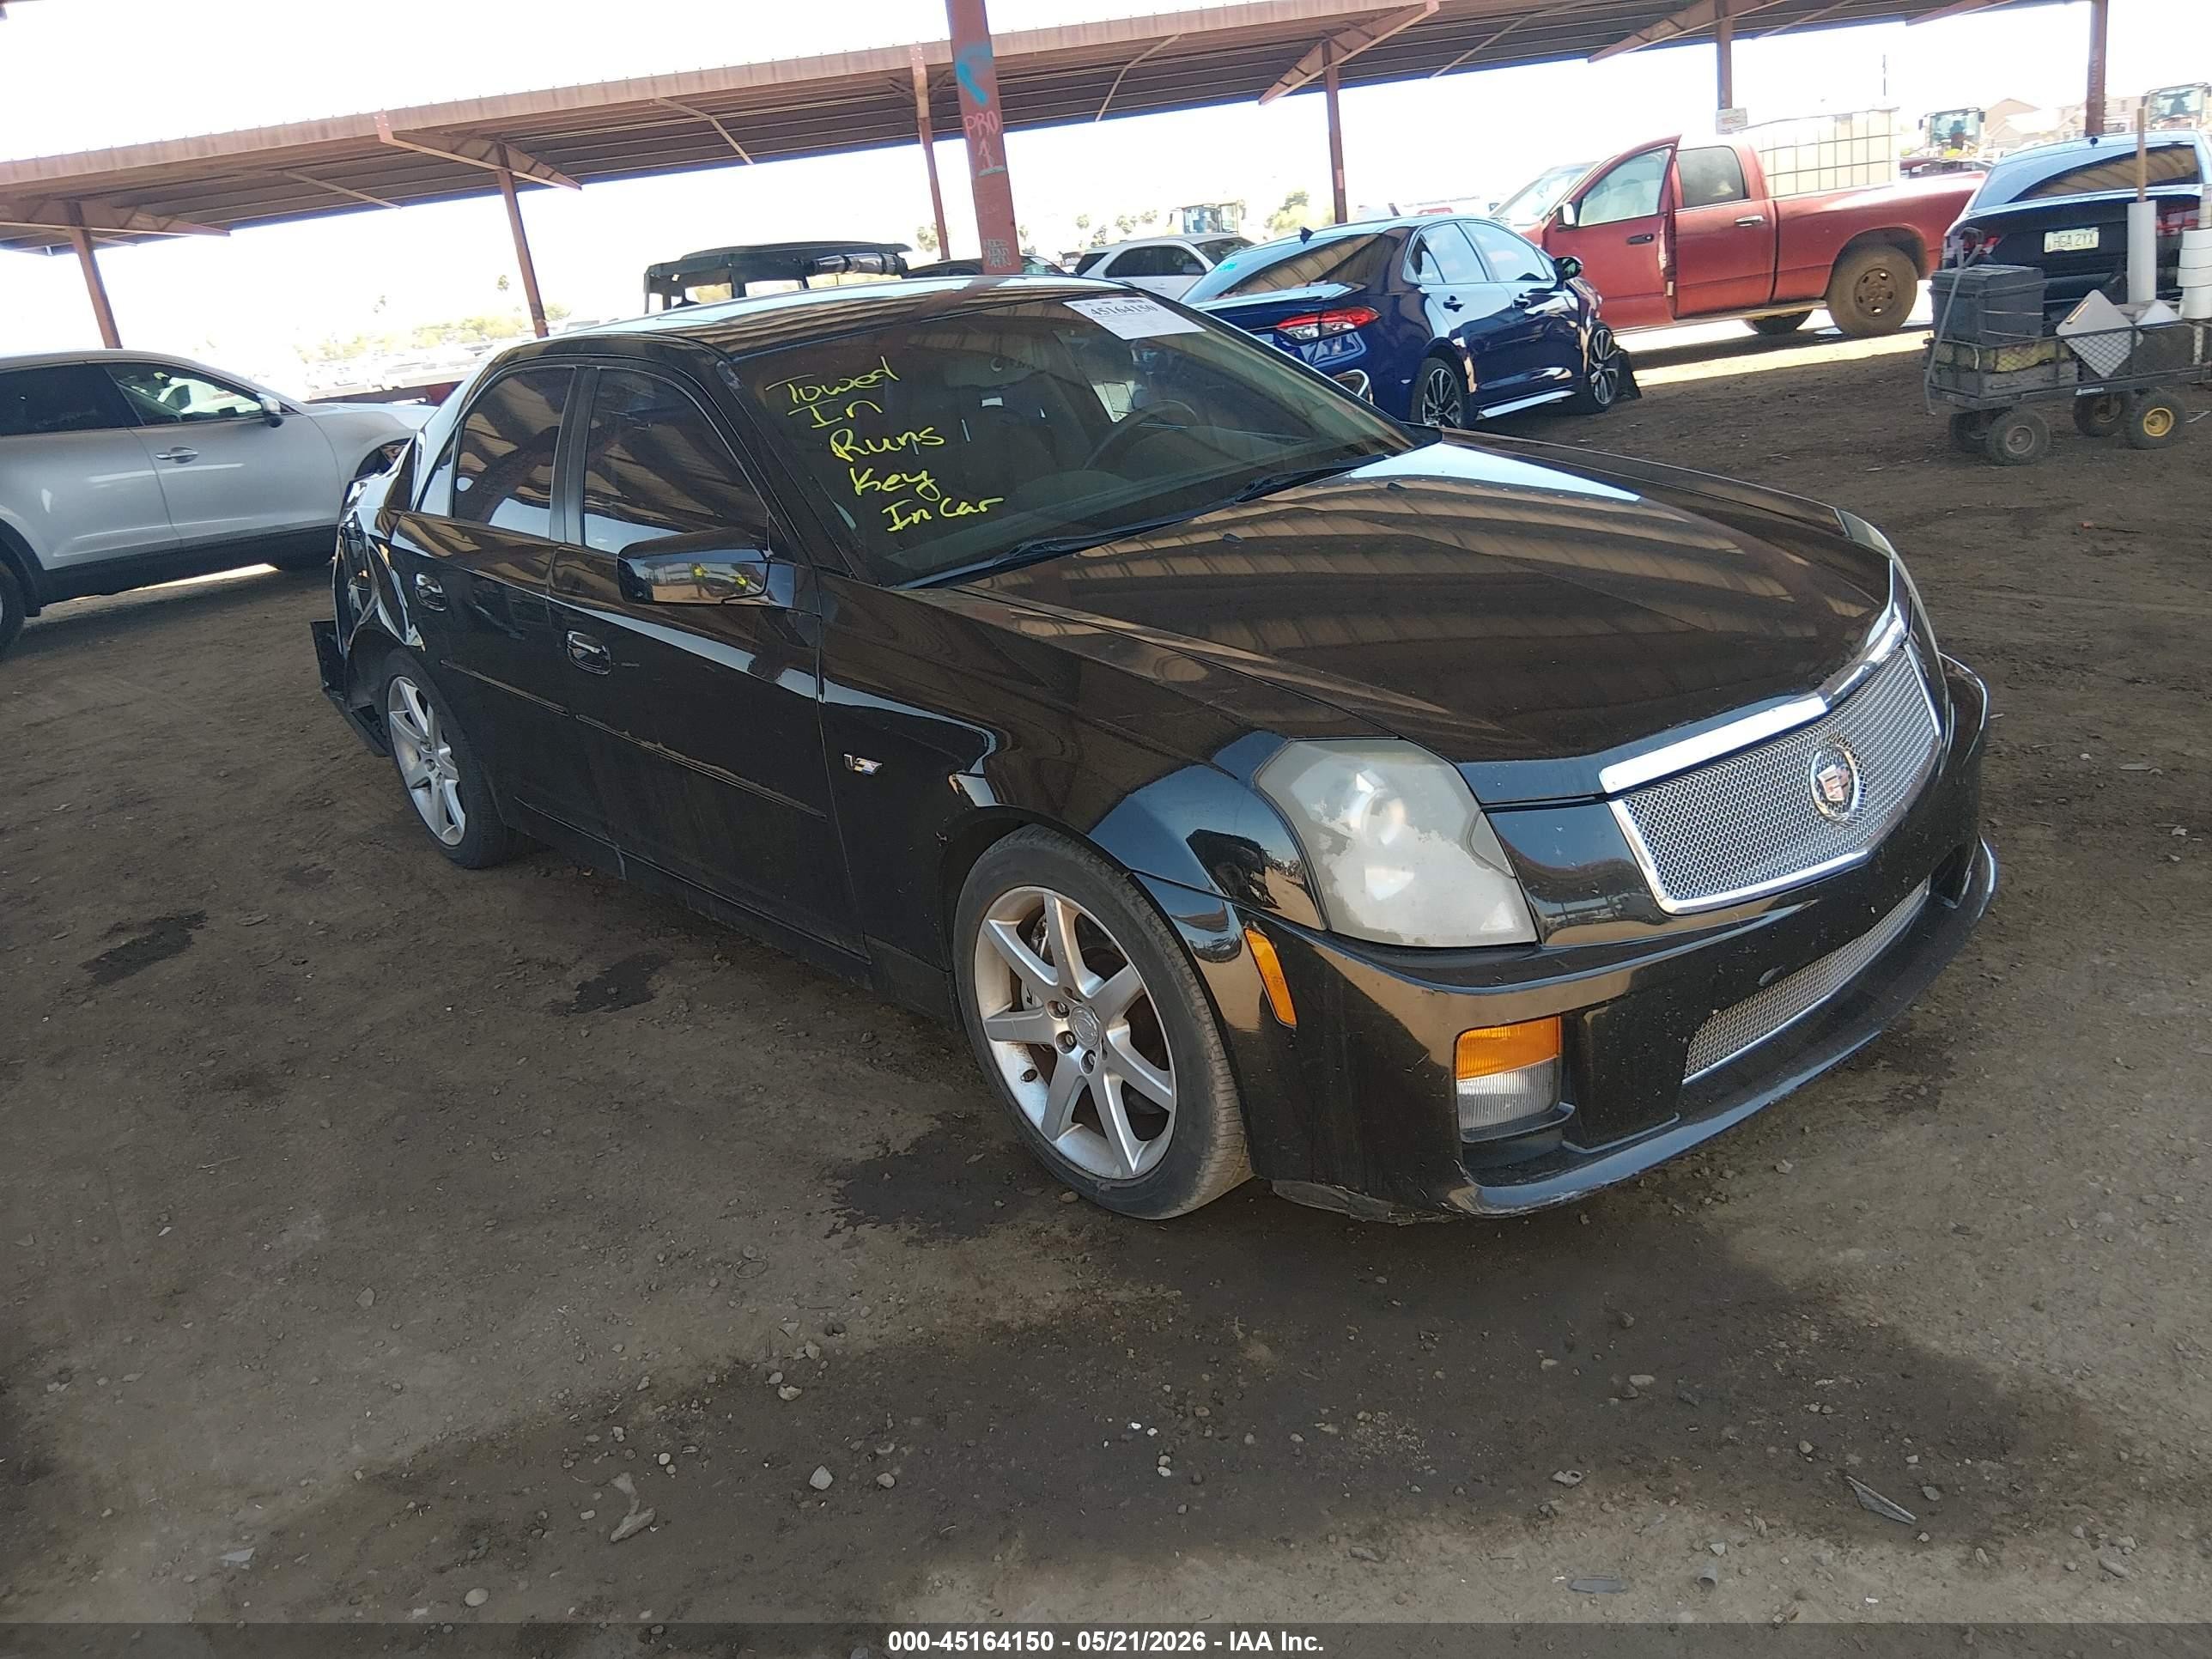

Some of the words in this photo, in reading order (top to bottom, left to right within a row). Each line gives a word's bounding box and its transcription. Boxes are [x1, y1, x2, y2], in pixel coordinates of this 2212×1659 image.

[1090, 304, 1158, 317] 45164150
[765, 356, 901, 404] Towed
[829, 427, 945, 462] Runs
[849, 467, 941, 501] Key
[881, 498, 933, 532] In
